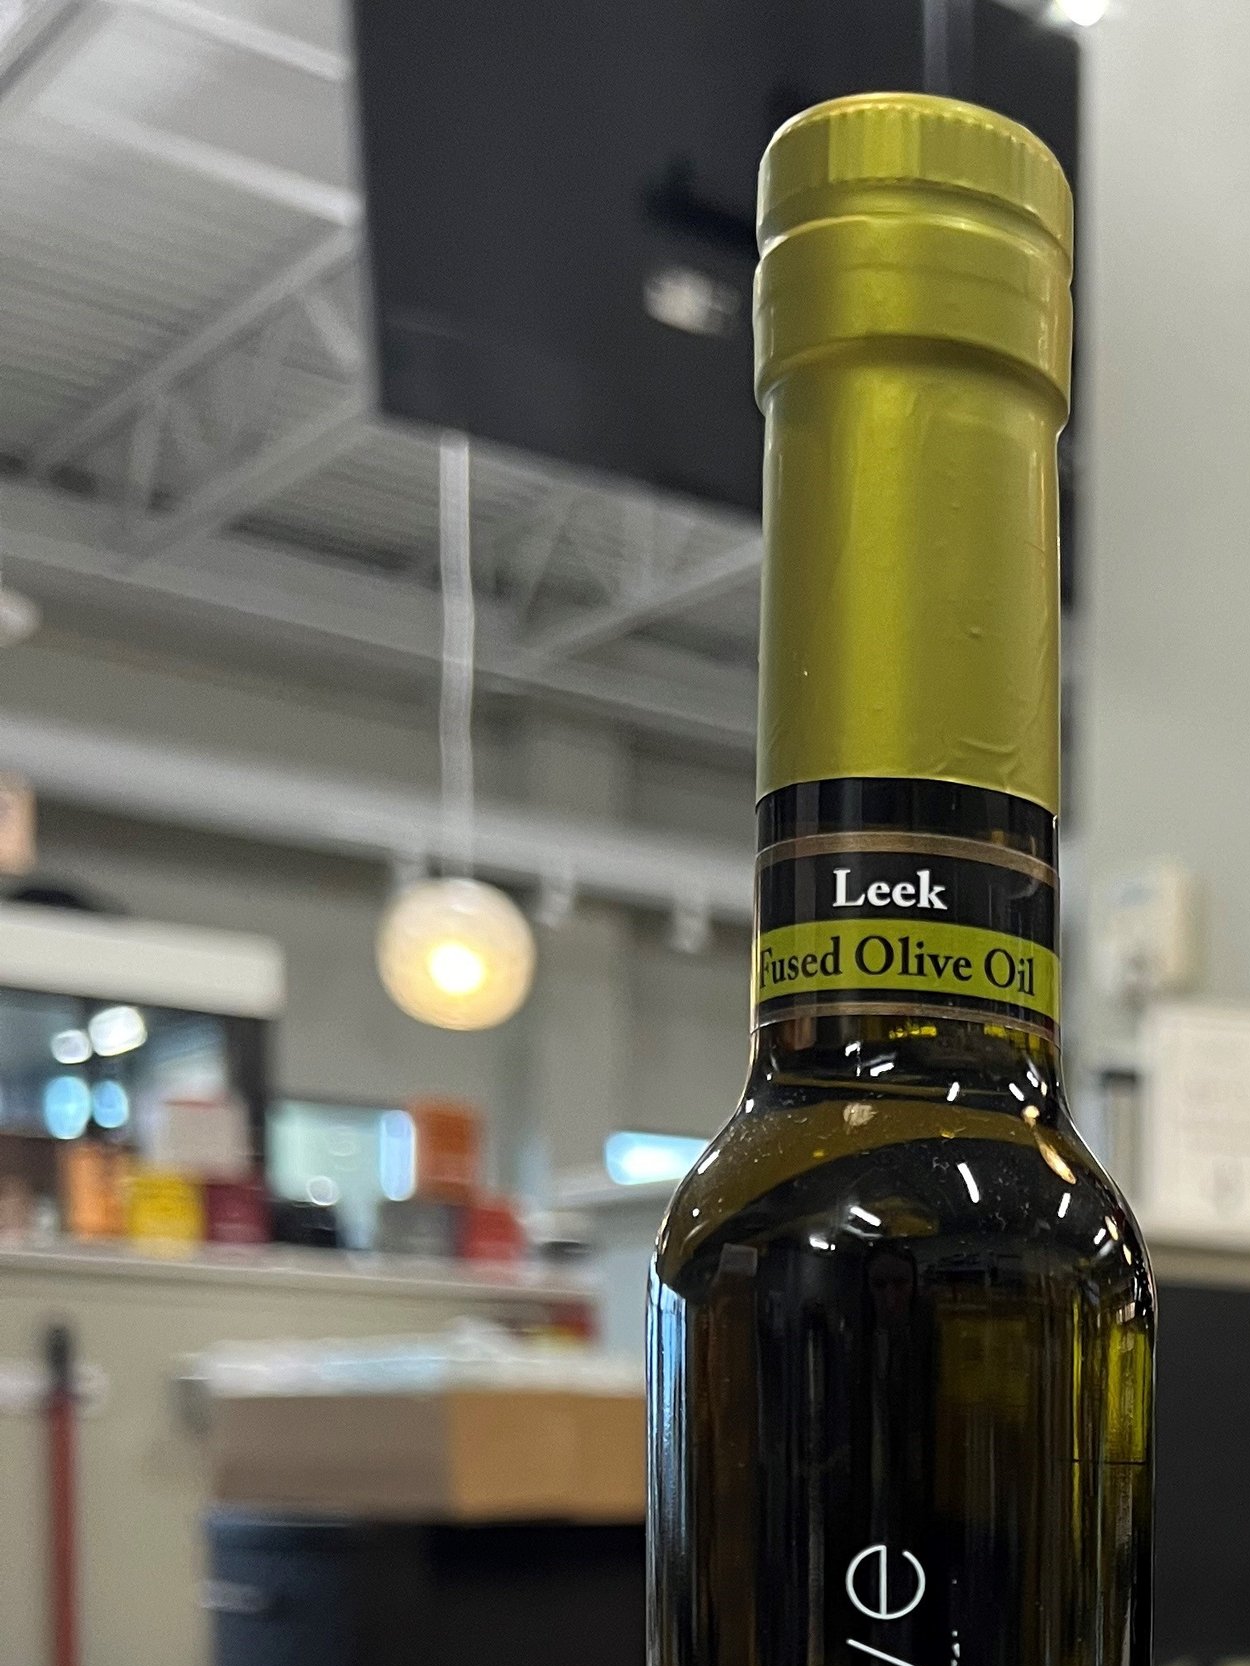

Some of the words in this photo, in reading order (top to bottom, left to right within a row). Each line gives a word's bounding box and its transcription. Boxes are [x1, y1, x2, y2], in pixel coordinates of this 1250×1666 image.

[832, 868, 948, 910] Leek
[760, 935, 843, 988] Fused
[855, 935, 973, 982] Olive
[984, 949, 1035, 996] Oil
